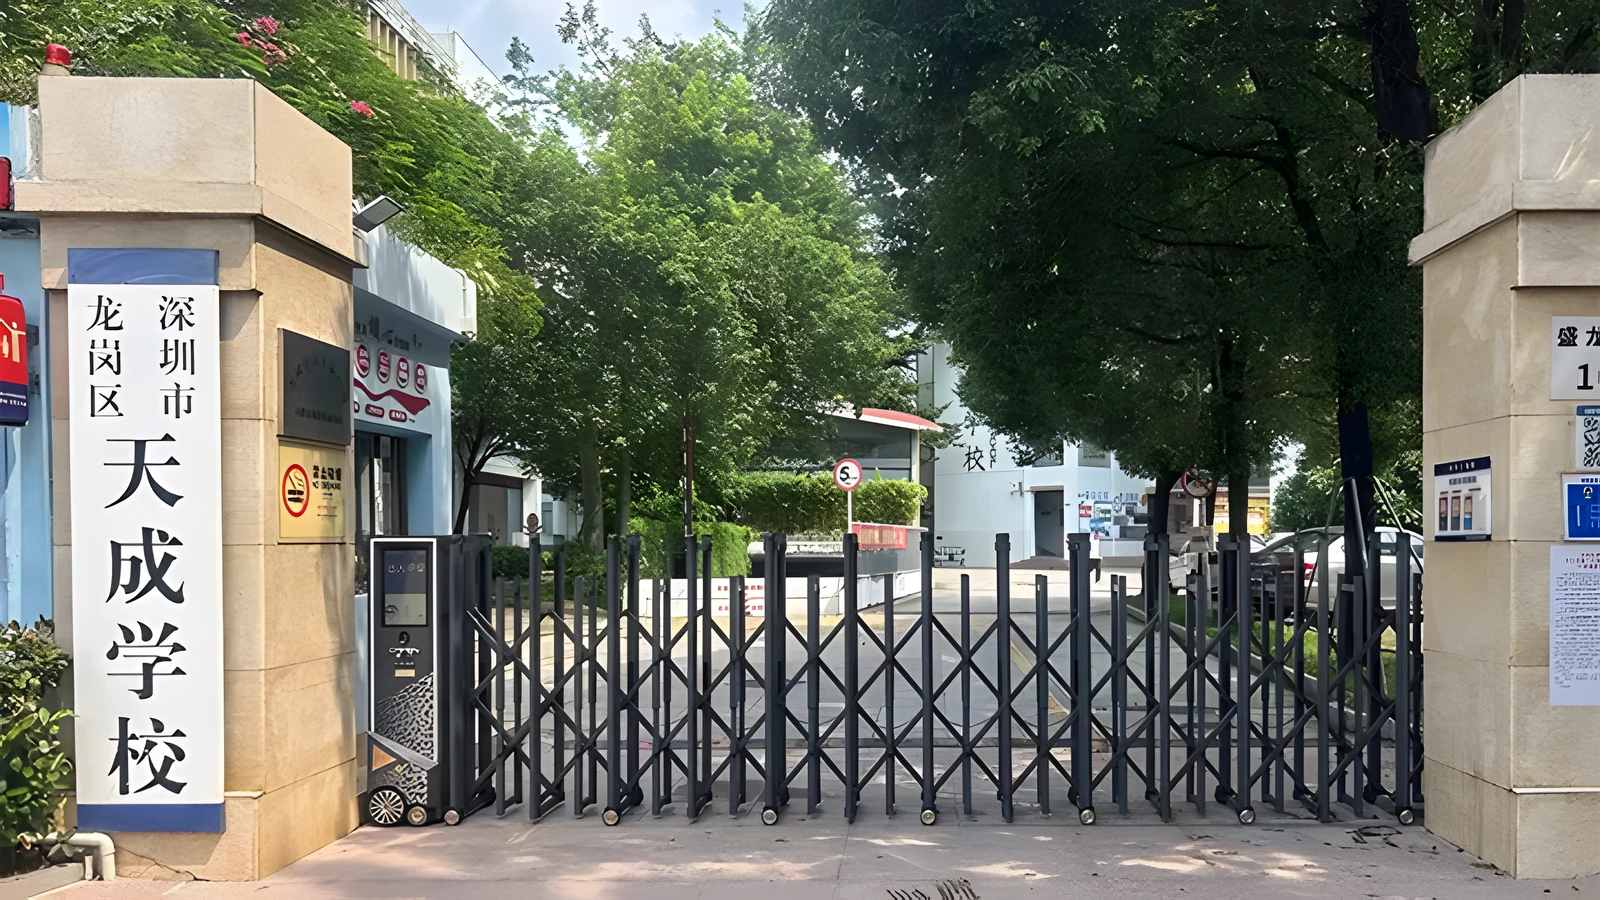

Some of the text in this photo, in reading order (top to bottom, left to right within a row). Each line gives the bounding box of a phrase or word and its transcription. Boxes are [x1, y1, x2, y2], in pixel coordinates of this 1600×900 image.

[86, 294, 124, 418] 龙岗区
[159, 295, 196, 419] 深圳市
[1576, 363, 1600, 391] 1
[962, 445, 986, 472] 校
[103, 432, 188, 796] 天成学校
